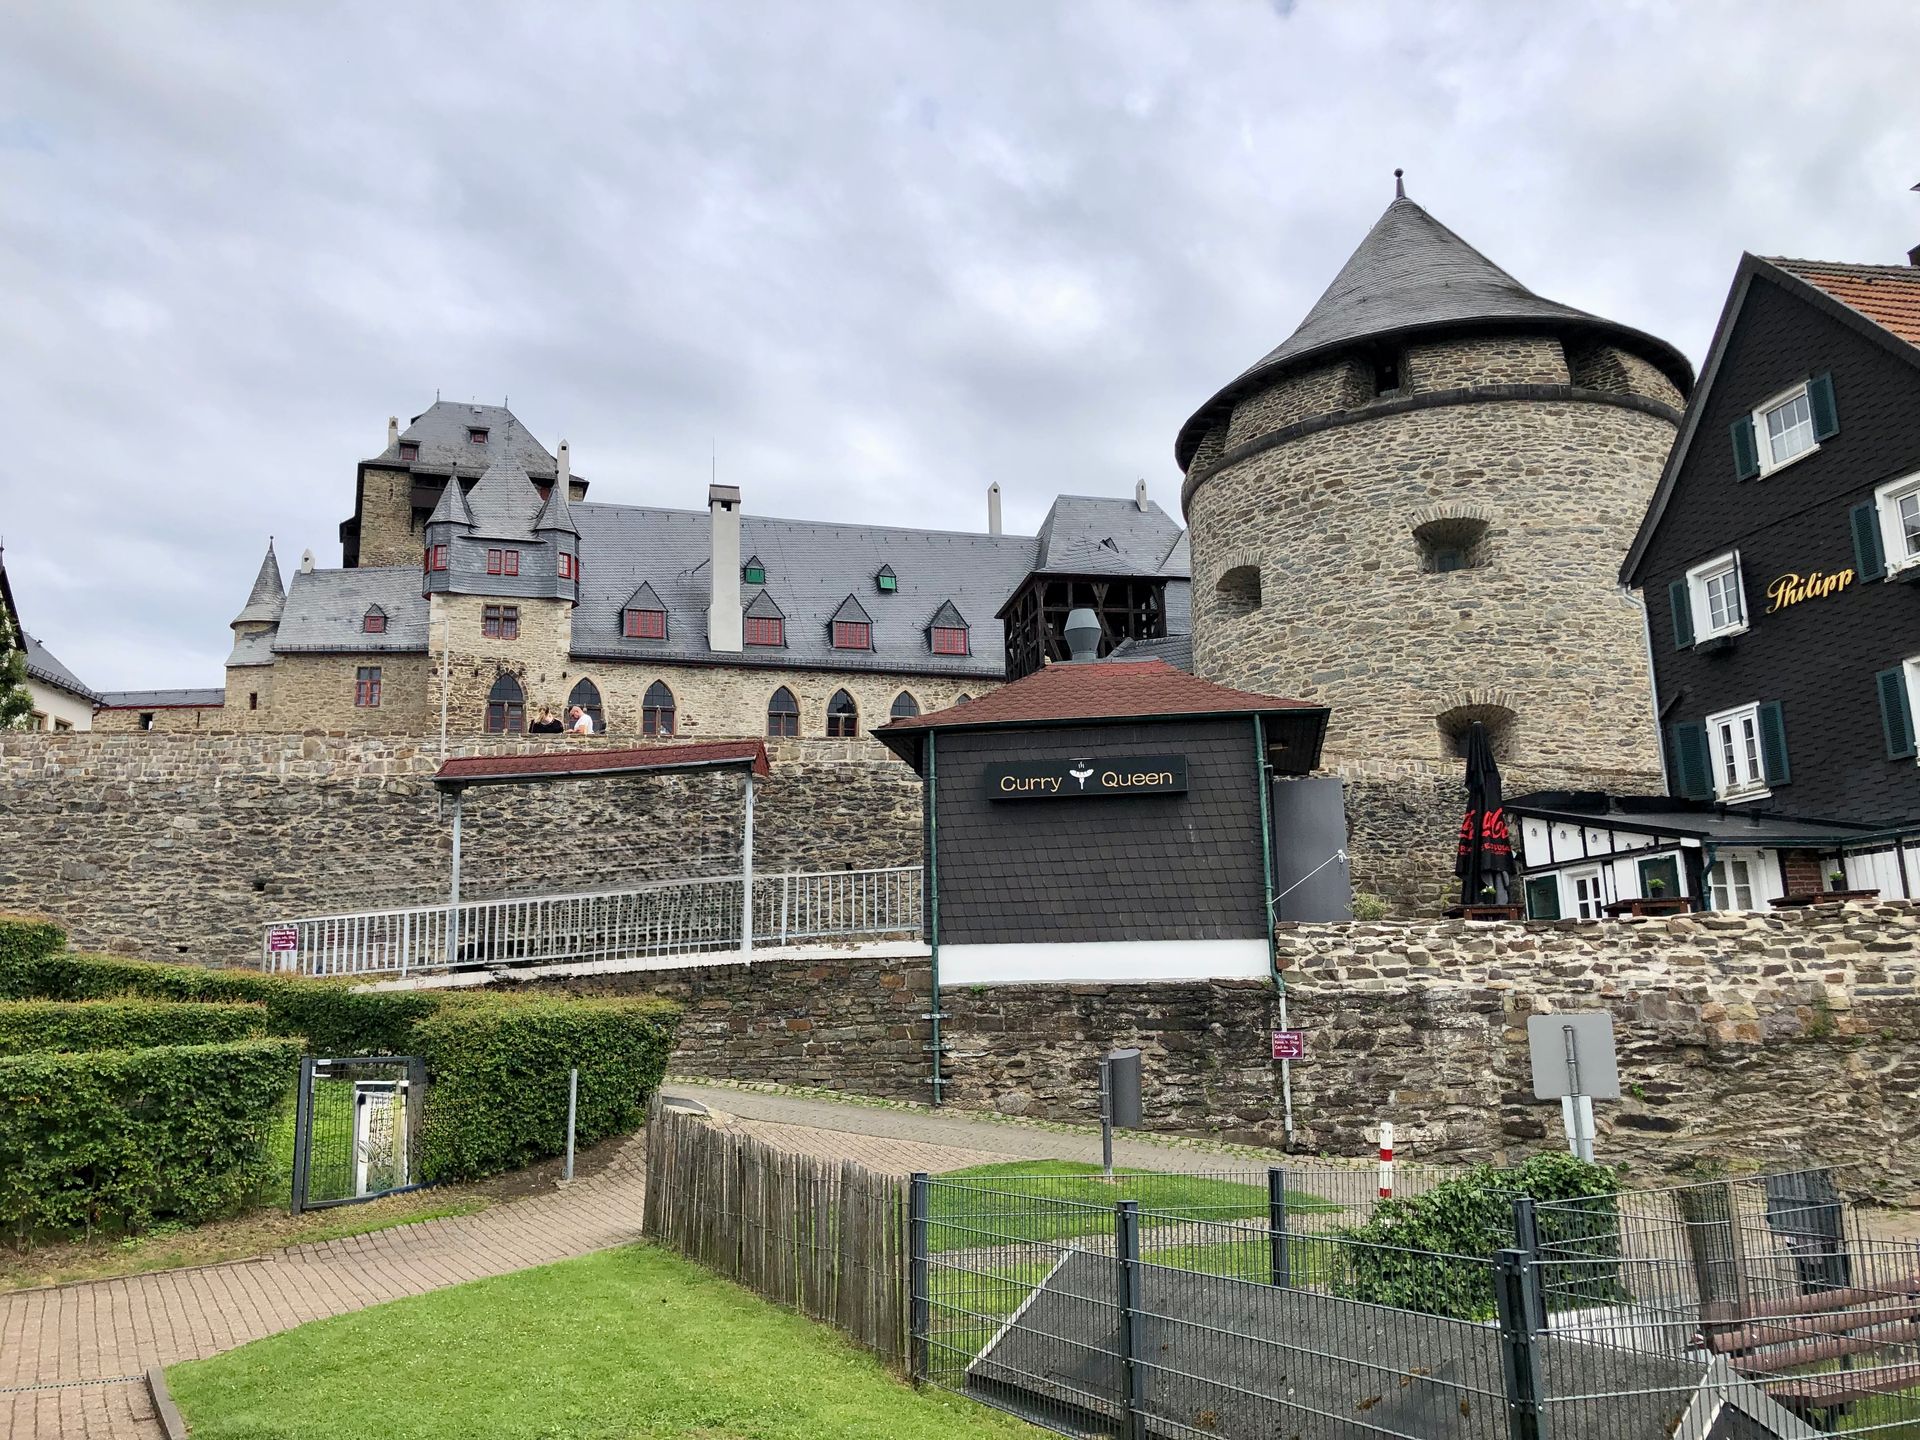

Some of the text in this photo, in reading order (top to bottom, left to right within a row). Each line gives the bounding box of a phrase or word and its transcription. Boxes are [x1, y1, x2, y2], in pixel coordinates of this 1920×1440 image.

[1765, 569, 1855, 614] Philipp
[1000, 771, 1173, 793] Curry Queen
